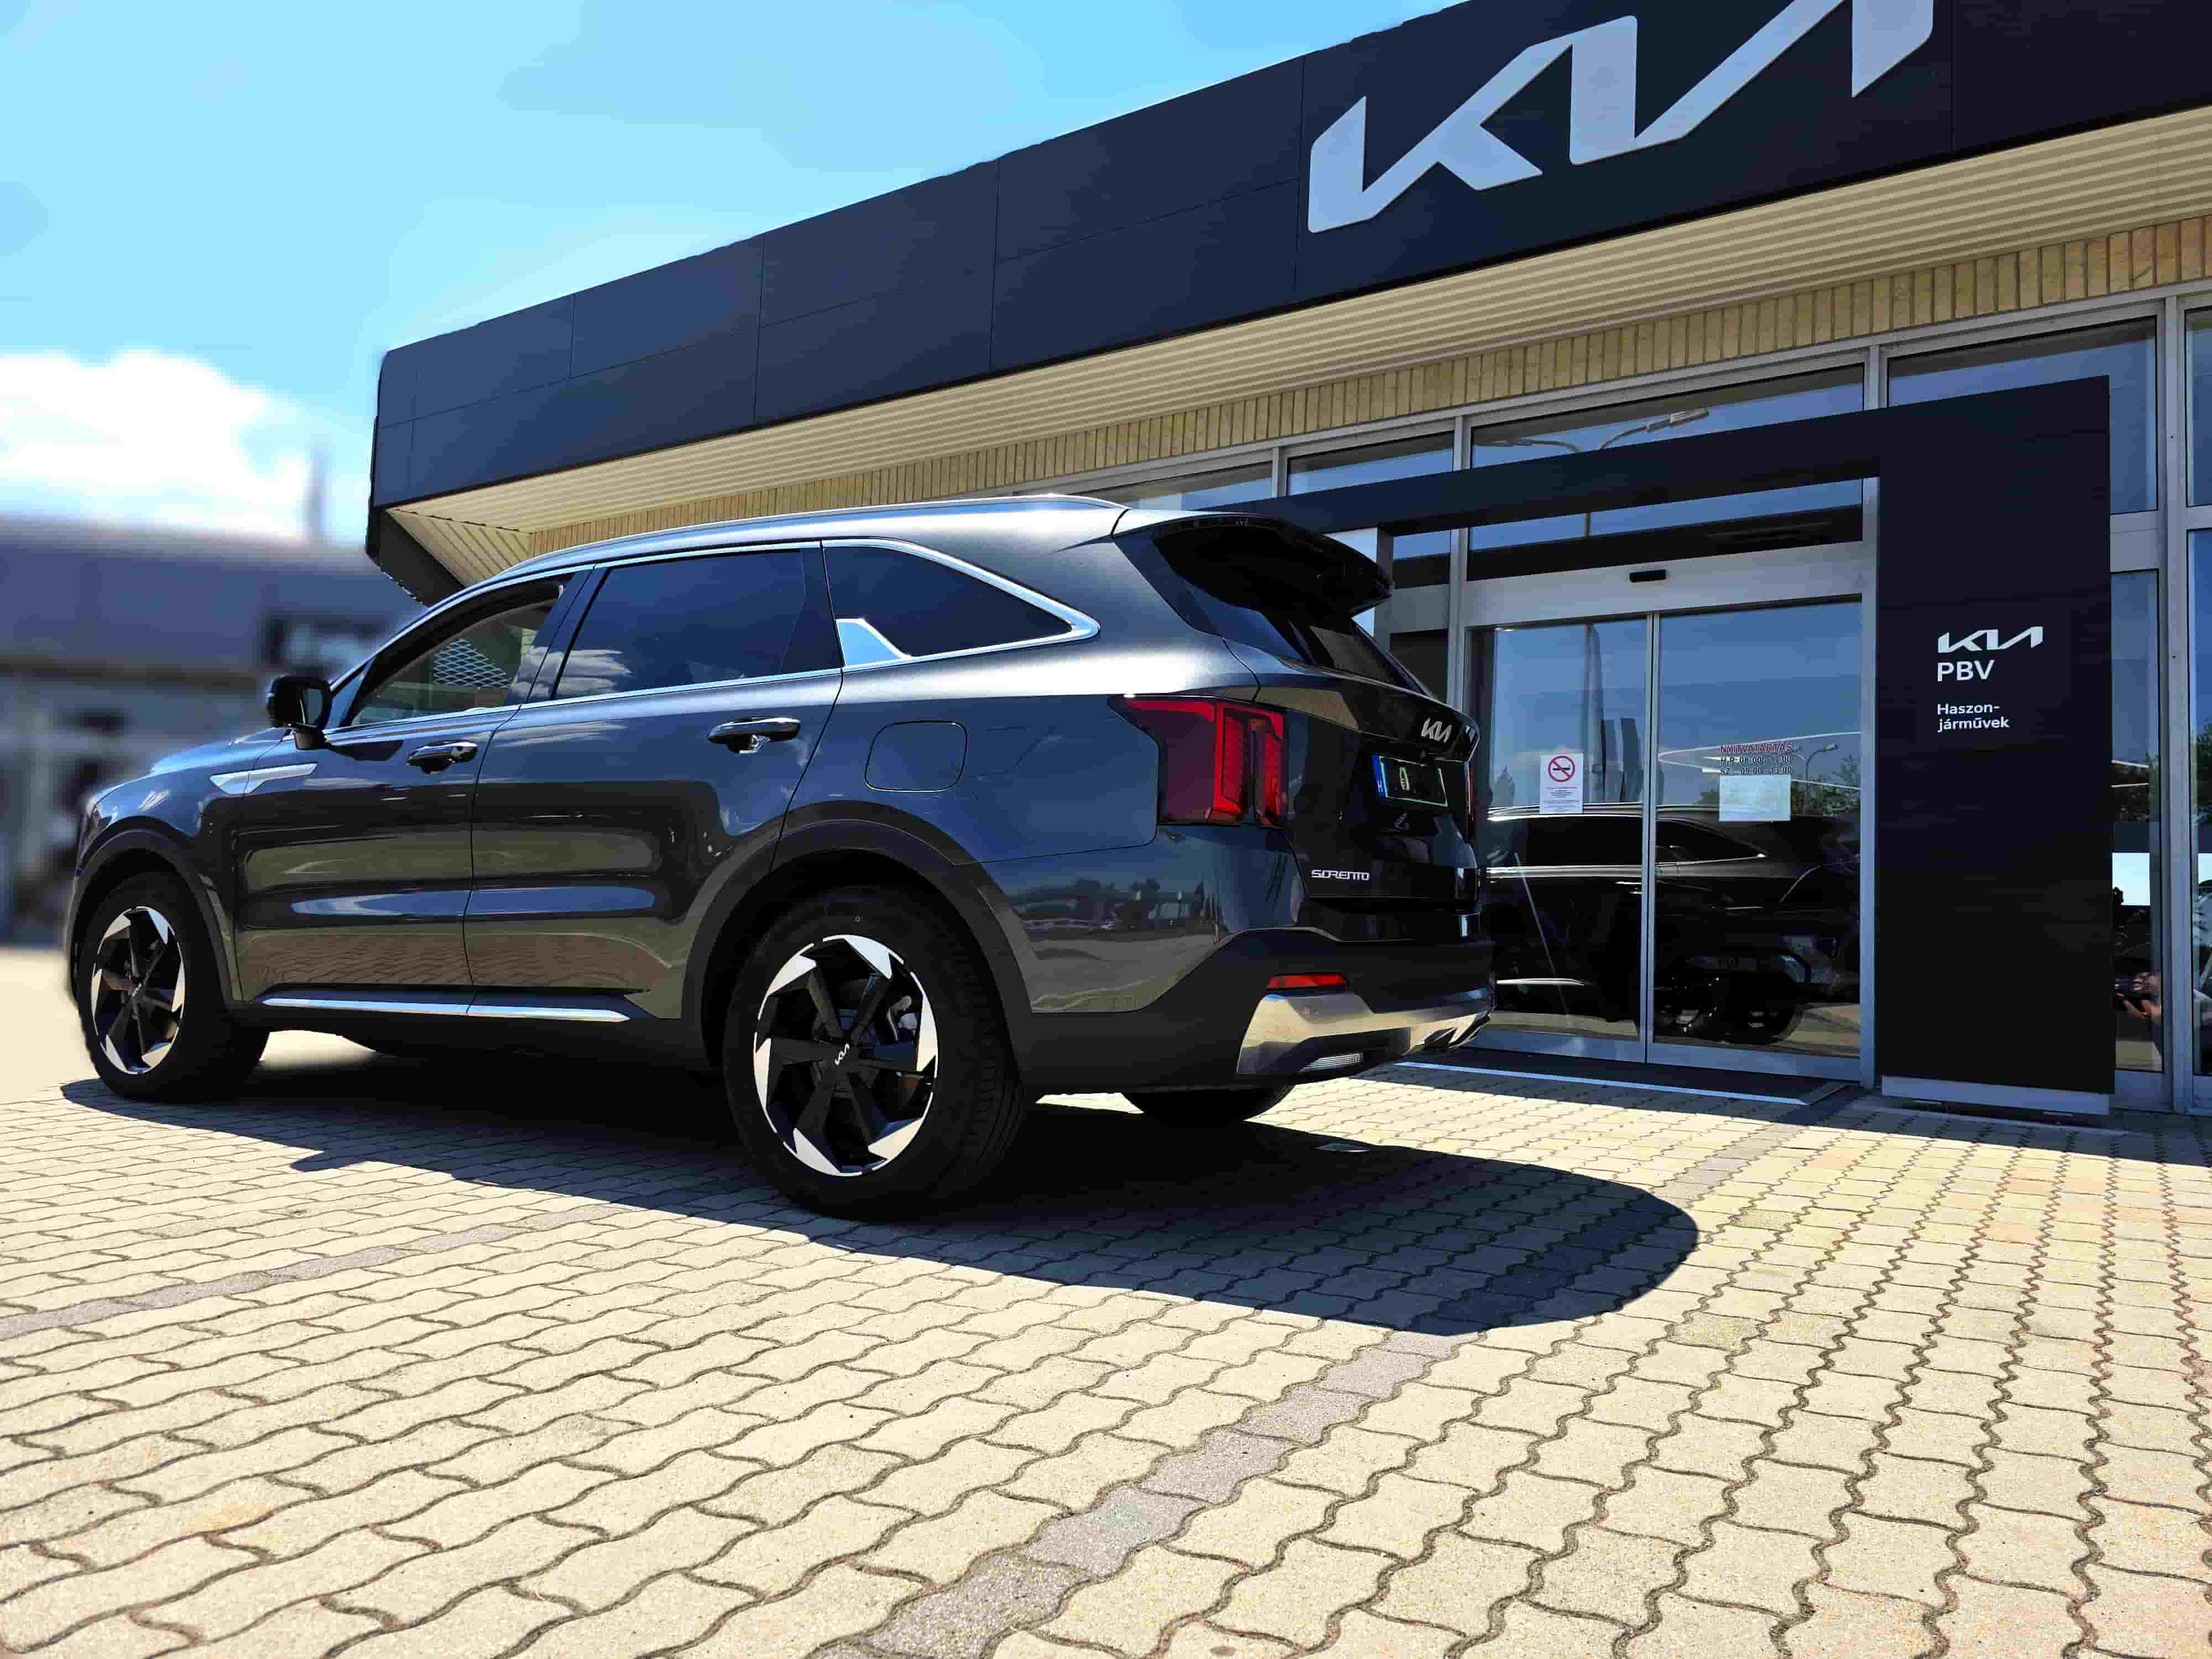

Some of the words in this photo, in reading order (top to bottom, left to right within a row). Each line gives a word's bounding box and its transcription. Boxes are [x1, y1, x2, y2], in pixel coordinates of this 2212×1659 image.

[1308, 0, 1933, 233] KIA
[1937, 626, 2044, 653] KIA
[1937, 660, 1995, 682] PBV
[1937, 703, 2000, 715] Haszon-
[1421, 718, 1453, 743] KIA
[1937, 717, 2010, 733] járművek
[1311, 868, 1370, 881] SORENTO
